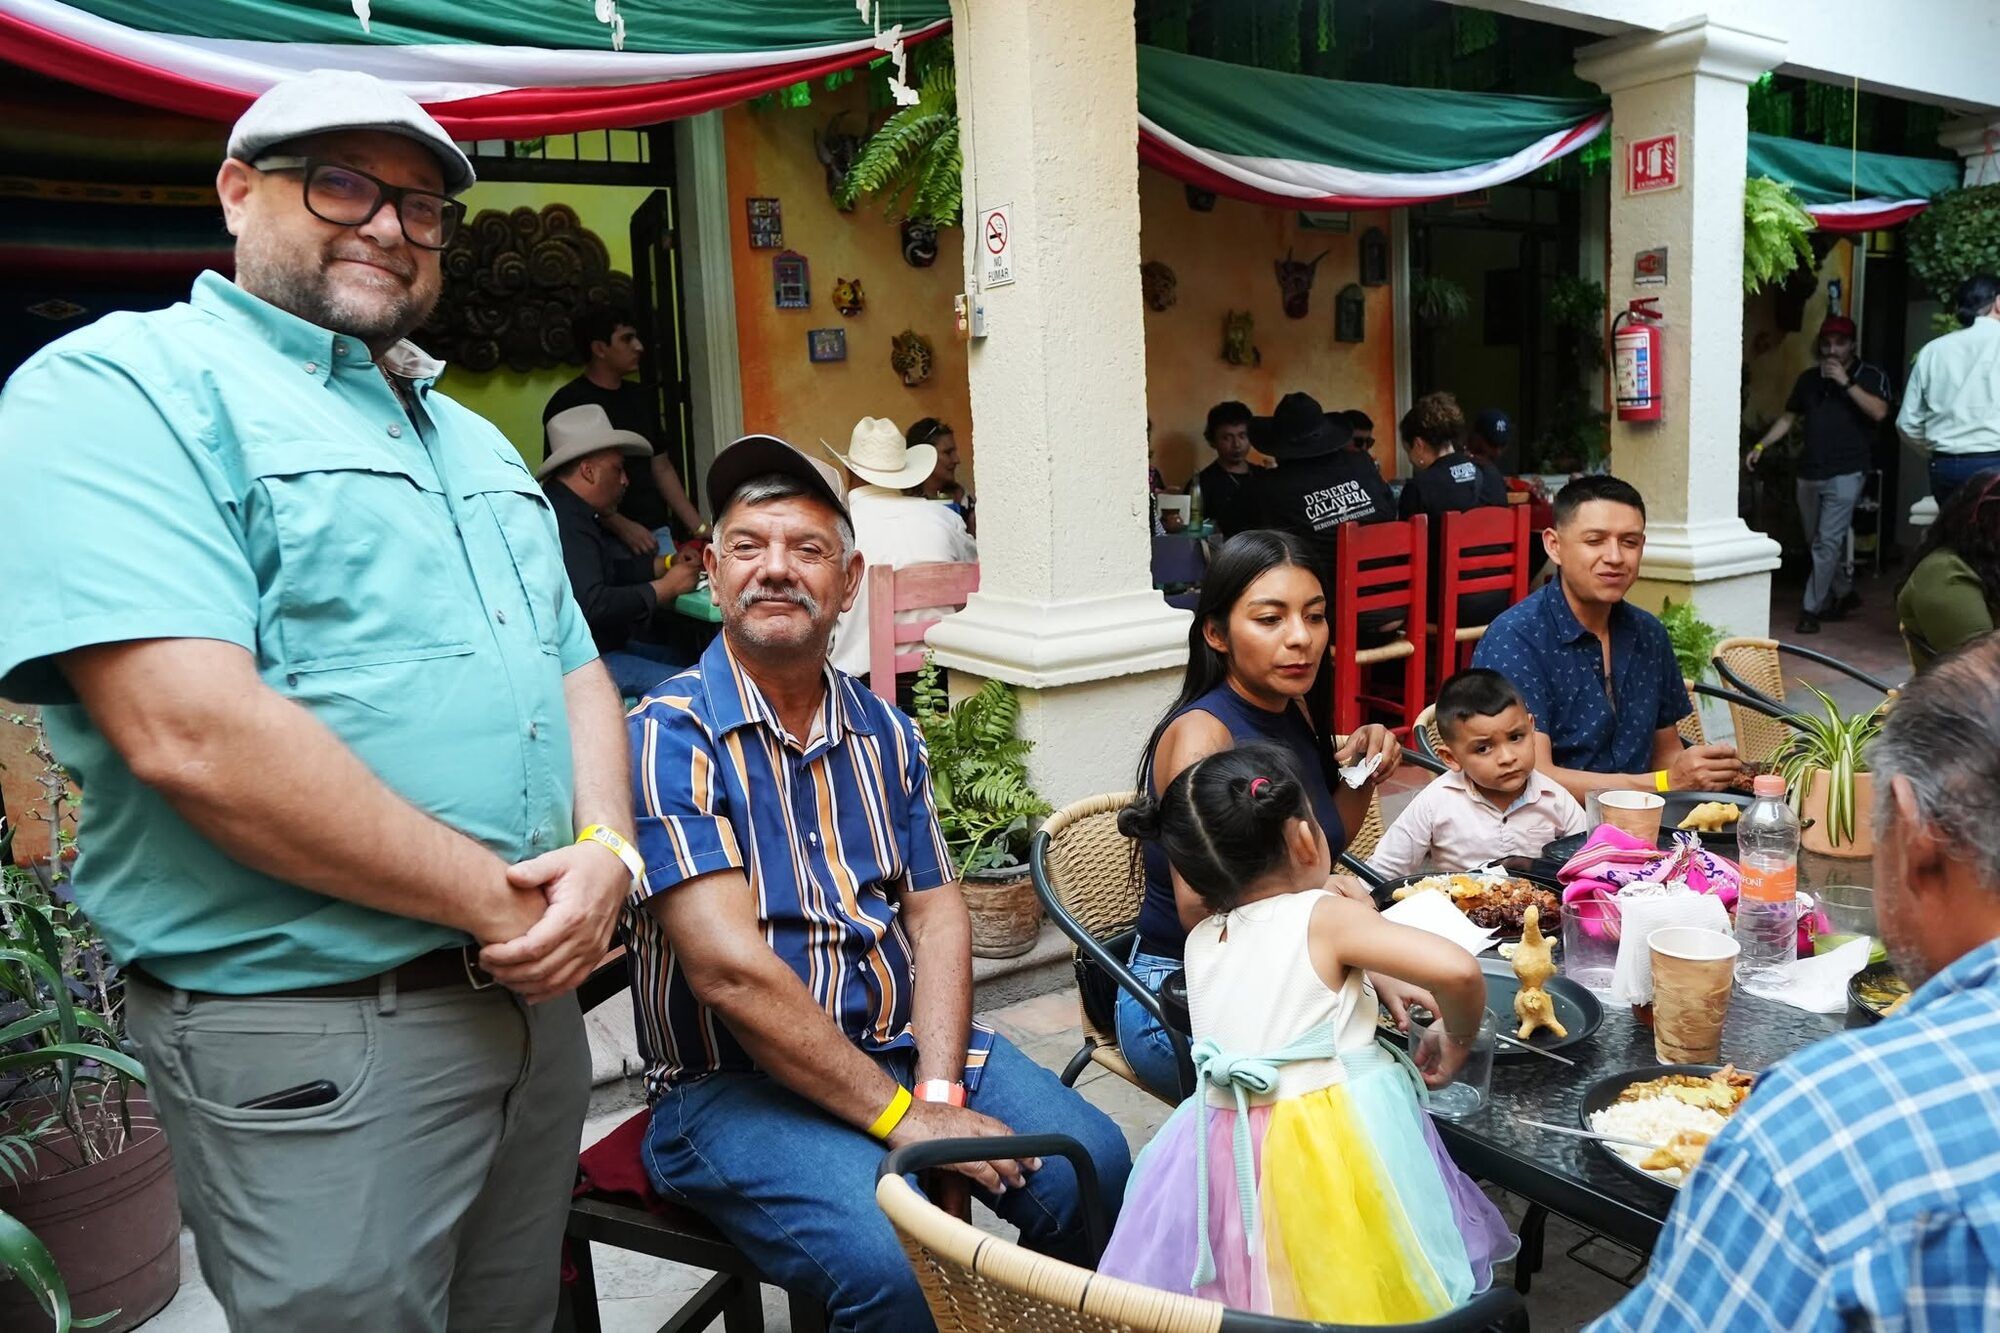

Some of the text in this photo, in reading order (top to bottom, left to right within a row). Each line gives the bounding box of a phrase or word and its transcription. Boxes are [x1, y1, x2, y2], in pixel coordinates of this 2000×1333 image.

[993, 256, 1002, 267] NO
[988, 267, 1009, 281] FUMAR
[1303, 480, 1360, 506] DESIERTO
[1305, 488, 1372, 520] CALAVERA
